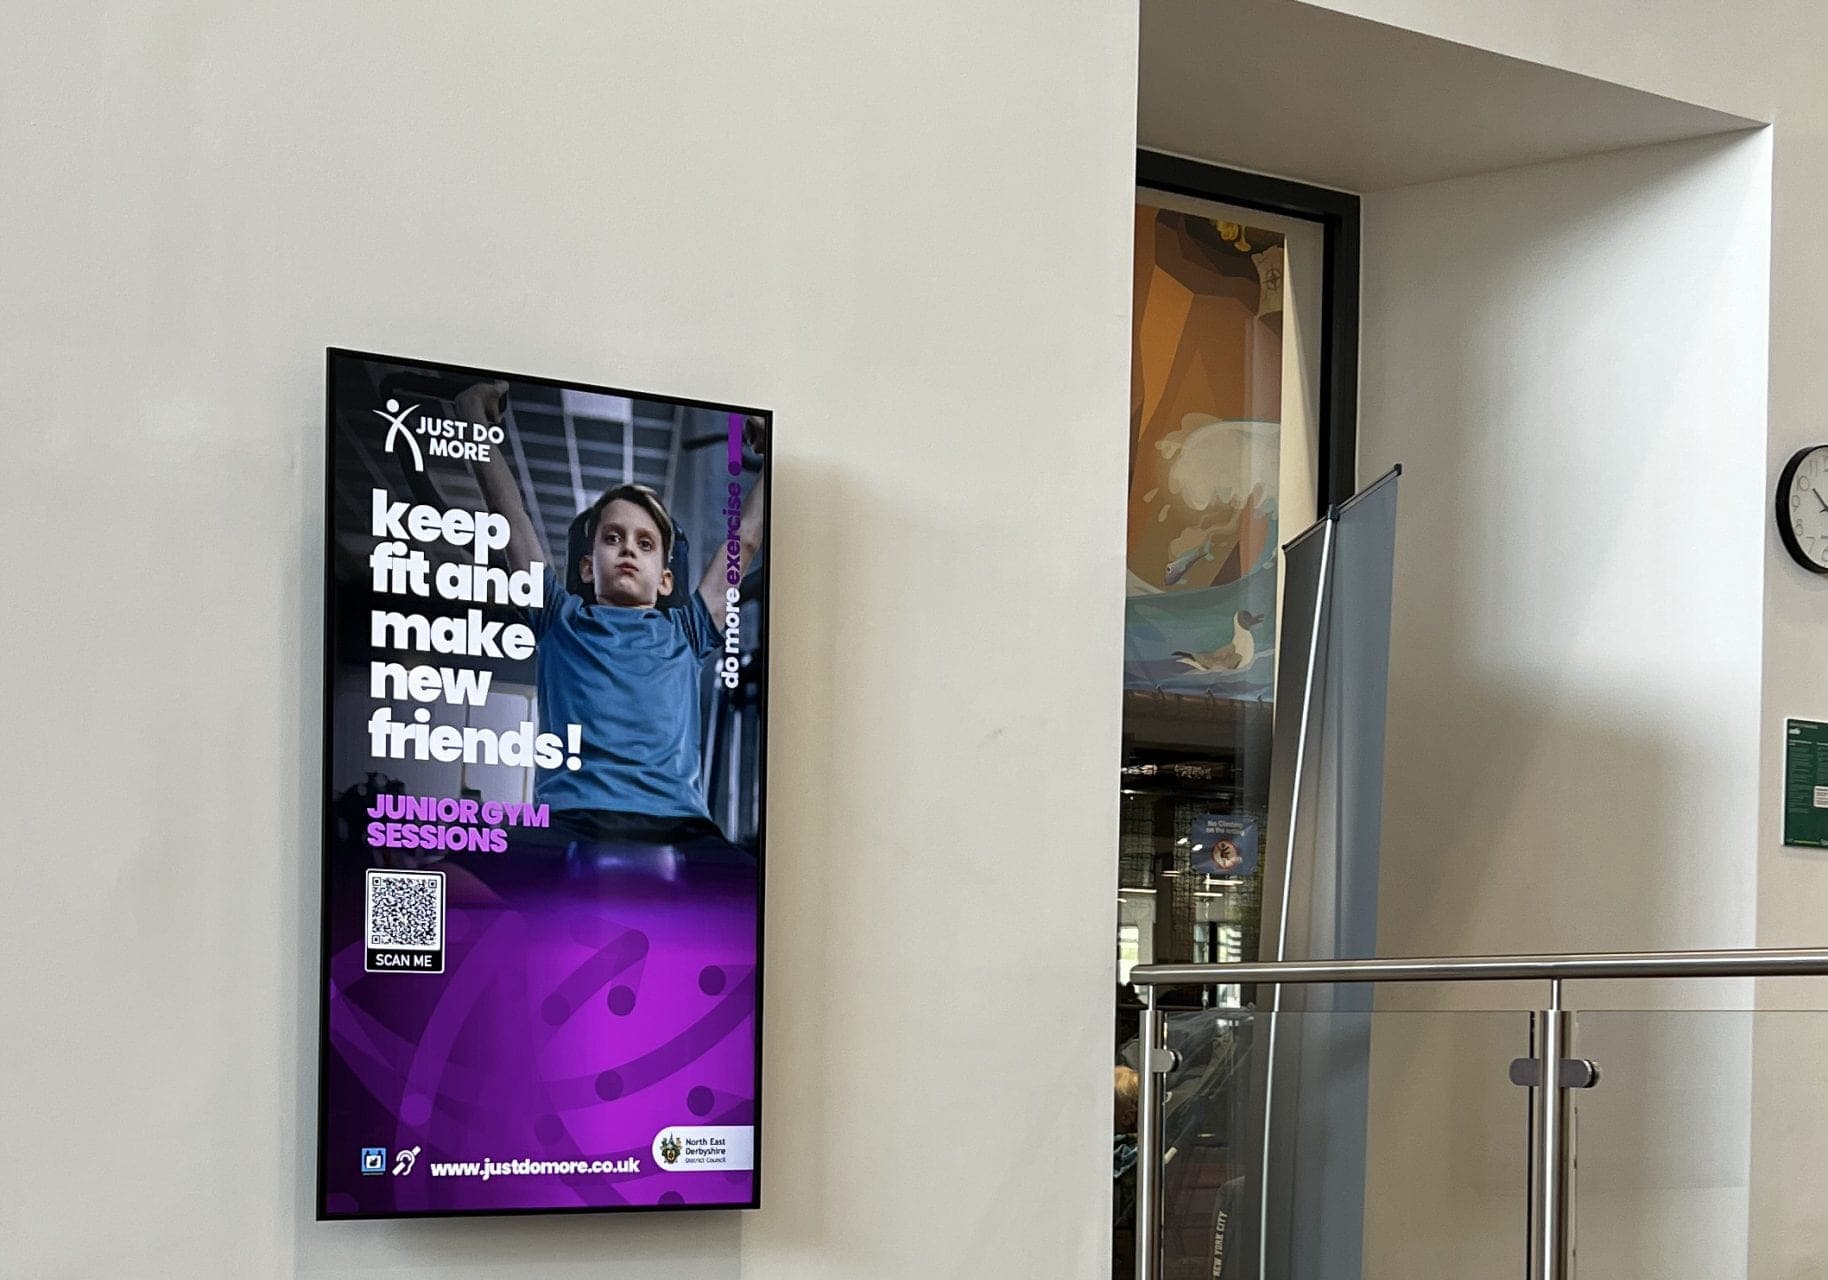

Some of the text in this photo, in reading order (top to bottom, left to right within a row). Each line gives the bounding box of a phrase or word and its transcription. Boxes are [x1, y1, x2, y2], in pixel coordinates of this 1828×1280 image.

[415, 416, 505, 444] JUST DO
[429, 438, 491, 462] MORE
[1796, 475, 1810, 492] 10
[1791, 494, 1801, 512] 9
[372, 488, 511, 564] keep
[1795, 518, 1803, 536] 8
[1806, 536, 1816, 554] 7
[370, 541, 544, 608] fit and
[721, 482, 742, 689] do more exercise
[371, 609, 536, 660] make
[370, 661, 492, 706] new
[368, 707, 582, 771] friends!
[367, 794, 550, 828] JUNIOR GYM
[367, 822, 508, 853] SESSIONS
[375, 953, 432, 967] SCAN ME
[685, 1137, 726, 1146] North East
[685, 1147, 726, 1156] Derbyshire
[430, 1157, 641, 1181] www.justdomore.co.uk
[1216, 1210, 1228, 1231] CITY
